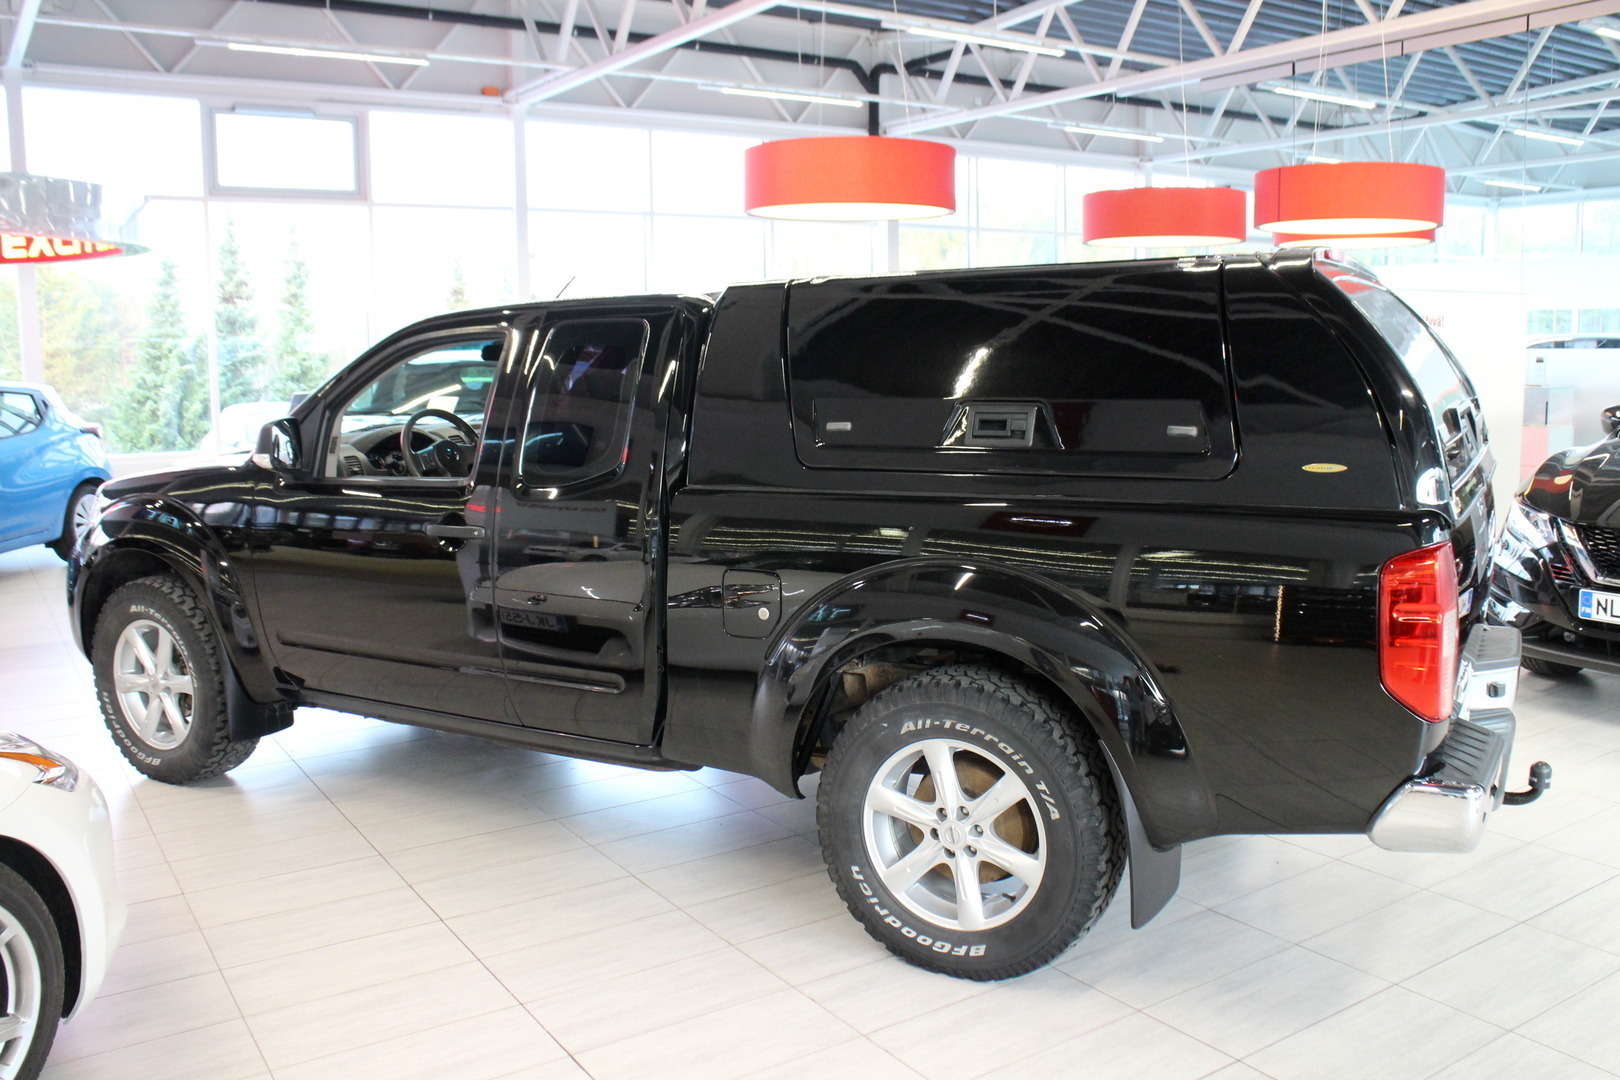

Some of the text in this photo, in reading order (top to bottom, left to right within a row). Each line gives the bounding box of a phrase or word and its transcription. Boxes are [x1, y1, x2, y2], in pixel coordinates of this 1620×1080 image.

[102, 691, 162, 766] BFGoodrich
[900, 719, 1061, 821] All-Terrain T/A
[850, 865, 987, 957] BFGoodrich
